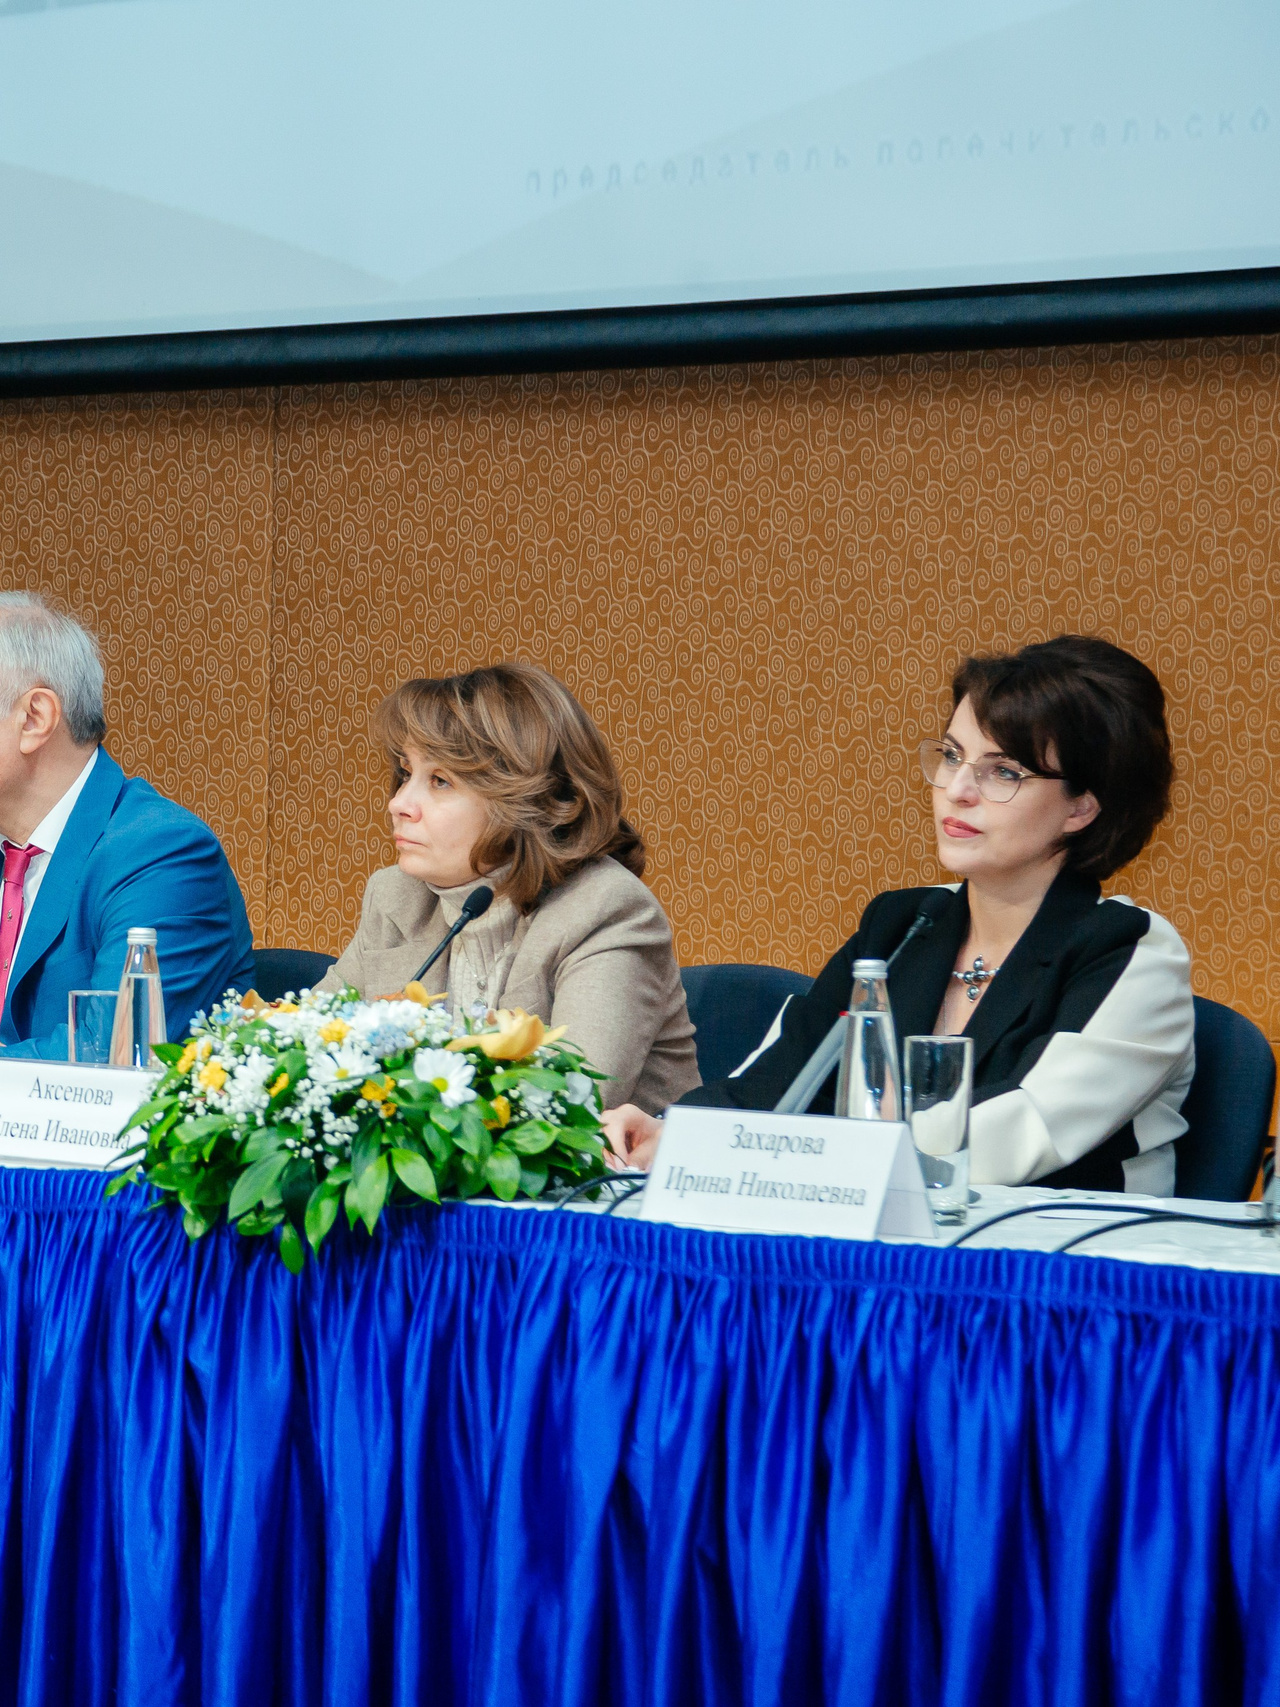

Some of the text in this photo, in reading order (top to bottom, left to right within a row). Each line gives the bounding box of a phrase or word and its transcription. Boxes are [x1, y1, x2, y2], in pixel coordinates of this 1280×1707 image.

[28, 1076, 114, 1106] Аксенова
[43, 1119, 131, 1151] Ивановна
[729, 1123, 826, 1159] Захарова
[664, 1165, 867, 1206] Ирина Николаевна
